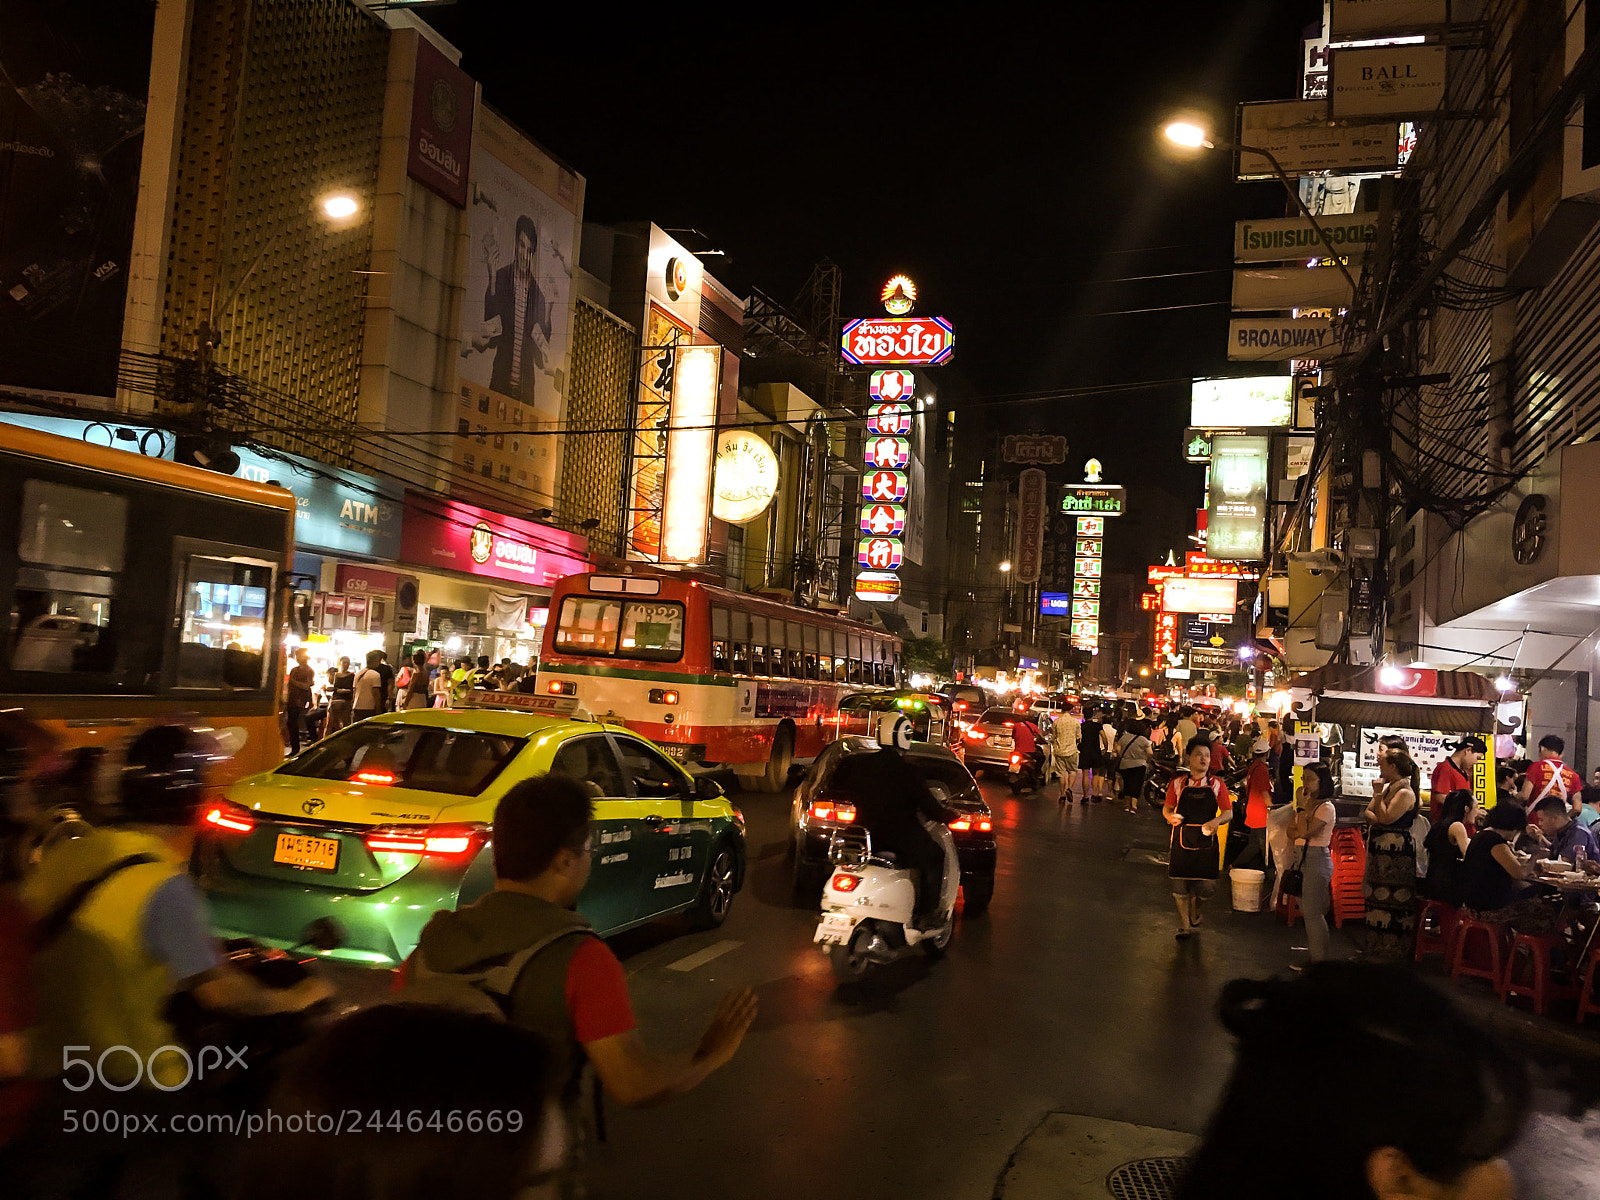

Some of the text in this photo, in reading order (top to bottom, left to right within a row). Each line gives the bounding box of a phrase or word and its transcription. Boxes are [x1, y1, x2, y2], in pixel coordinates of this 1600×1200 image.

[1361, 64, 1418, 82] BALL
[92, 259, 119, 279] VISA
[853, 323, 942, 357] ทองใบ
[1237, 327, 1327, 348] BROADWAY
[339, 497, 379, 526] ATM
[346, 578, 369, 592] GSB
[856, 581, 900, 591] EXCHANGE
[480, 693, 558, 709] TAXI-METER
[306, 839, 336, 857] 5716
